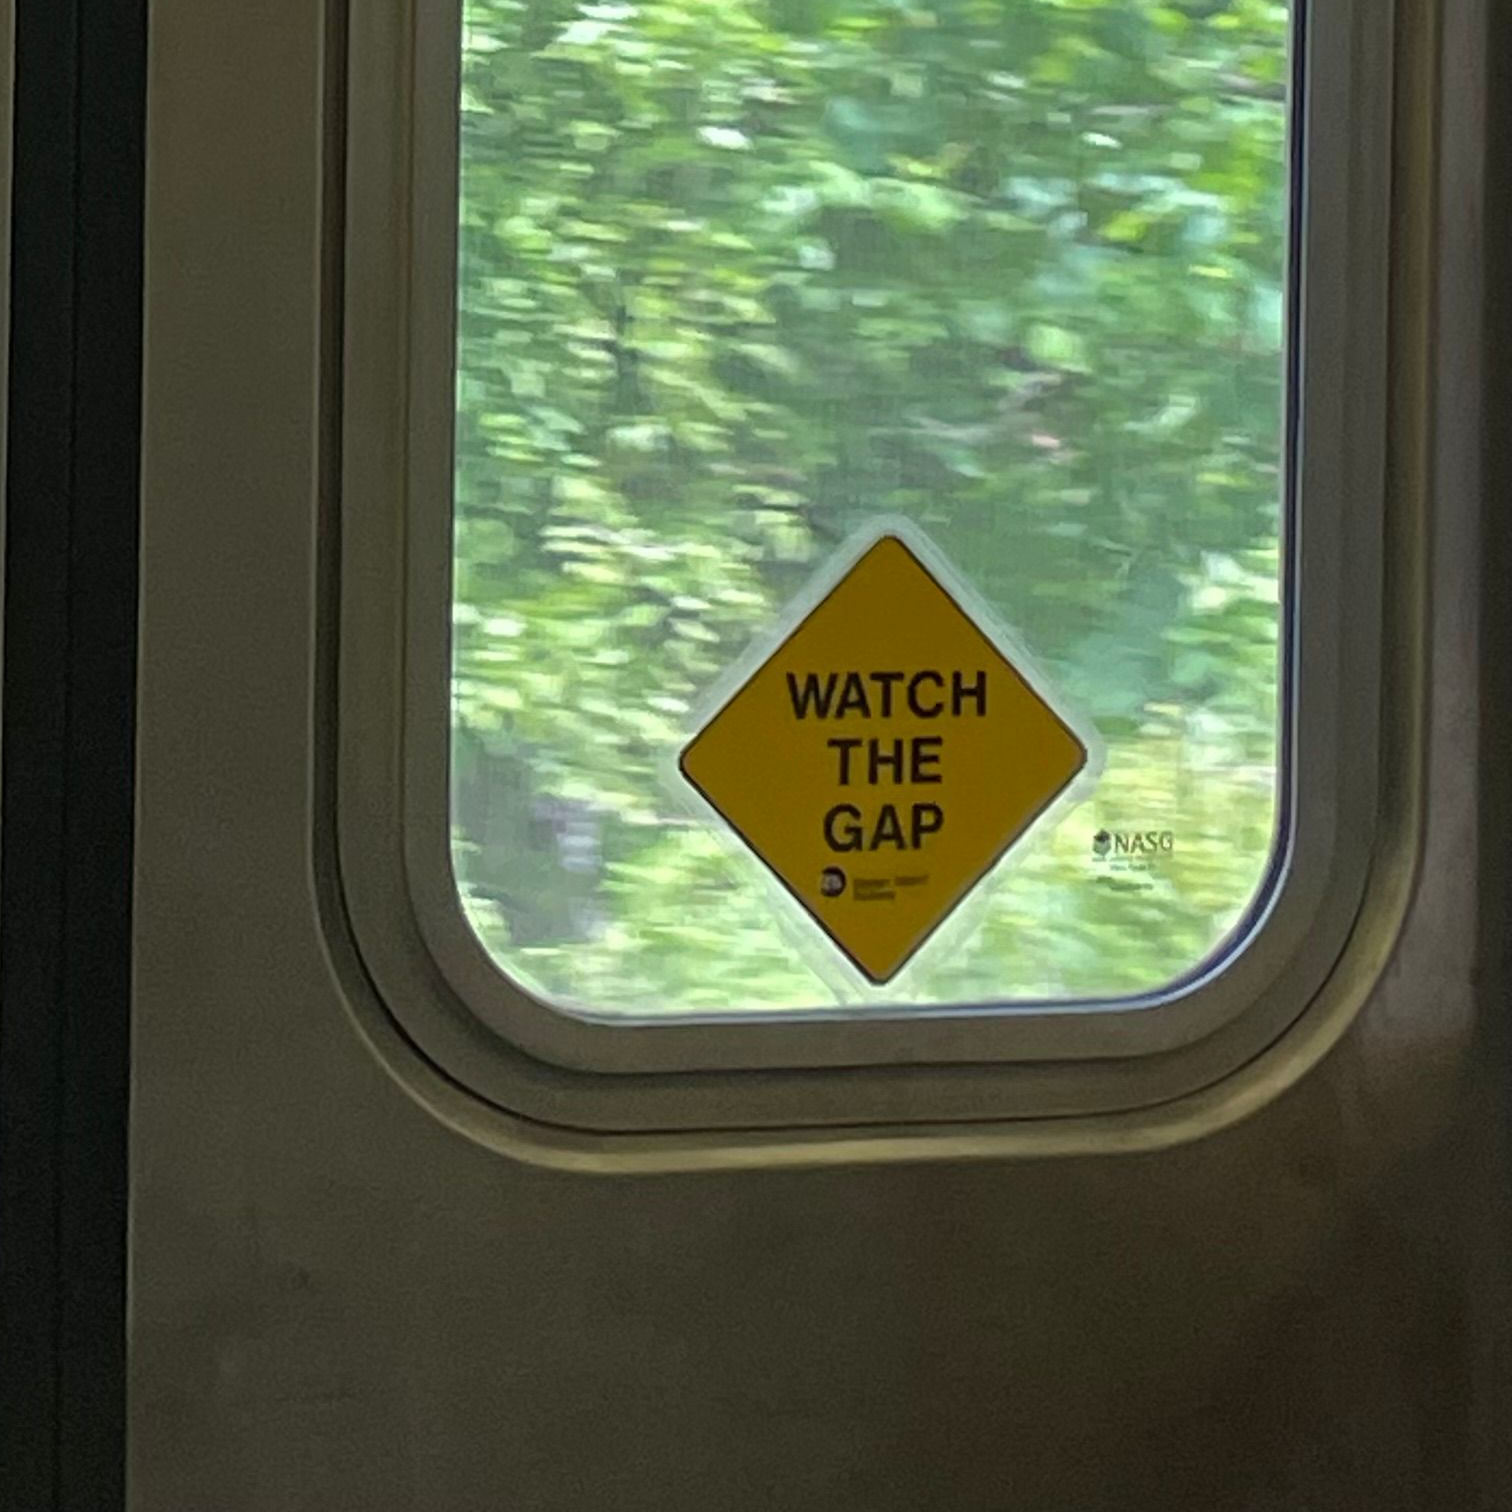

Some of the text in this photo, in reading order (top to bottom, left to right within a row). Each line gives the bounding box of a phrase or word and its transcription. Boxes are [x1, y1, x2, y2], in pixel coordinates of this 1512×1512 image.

[784, 669, 988, 721] WATCH
[825, 734, 945, 787] THE
[822, 801, 945, 854] GAP
[1114, 830, 1174, 854] NASG
